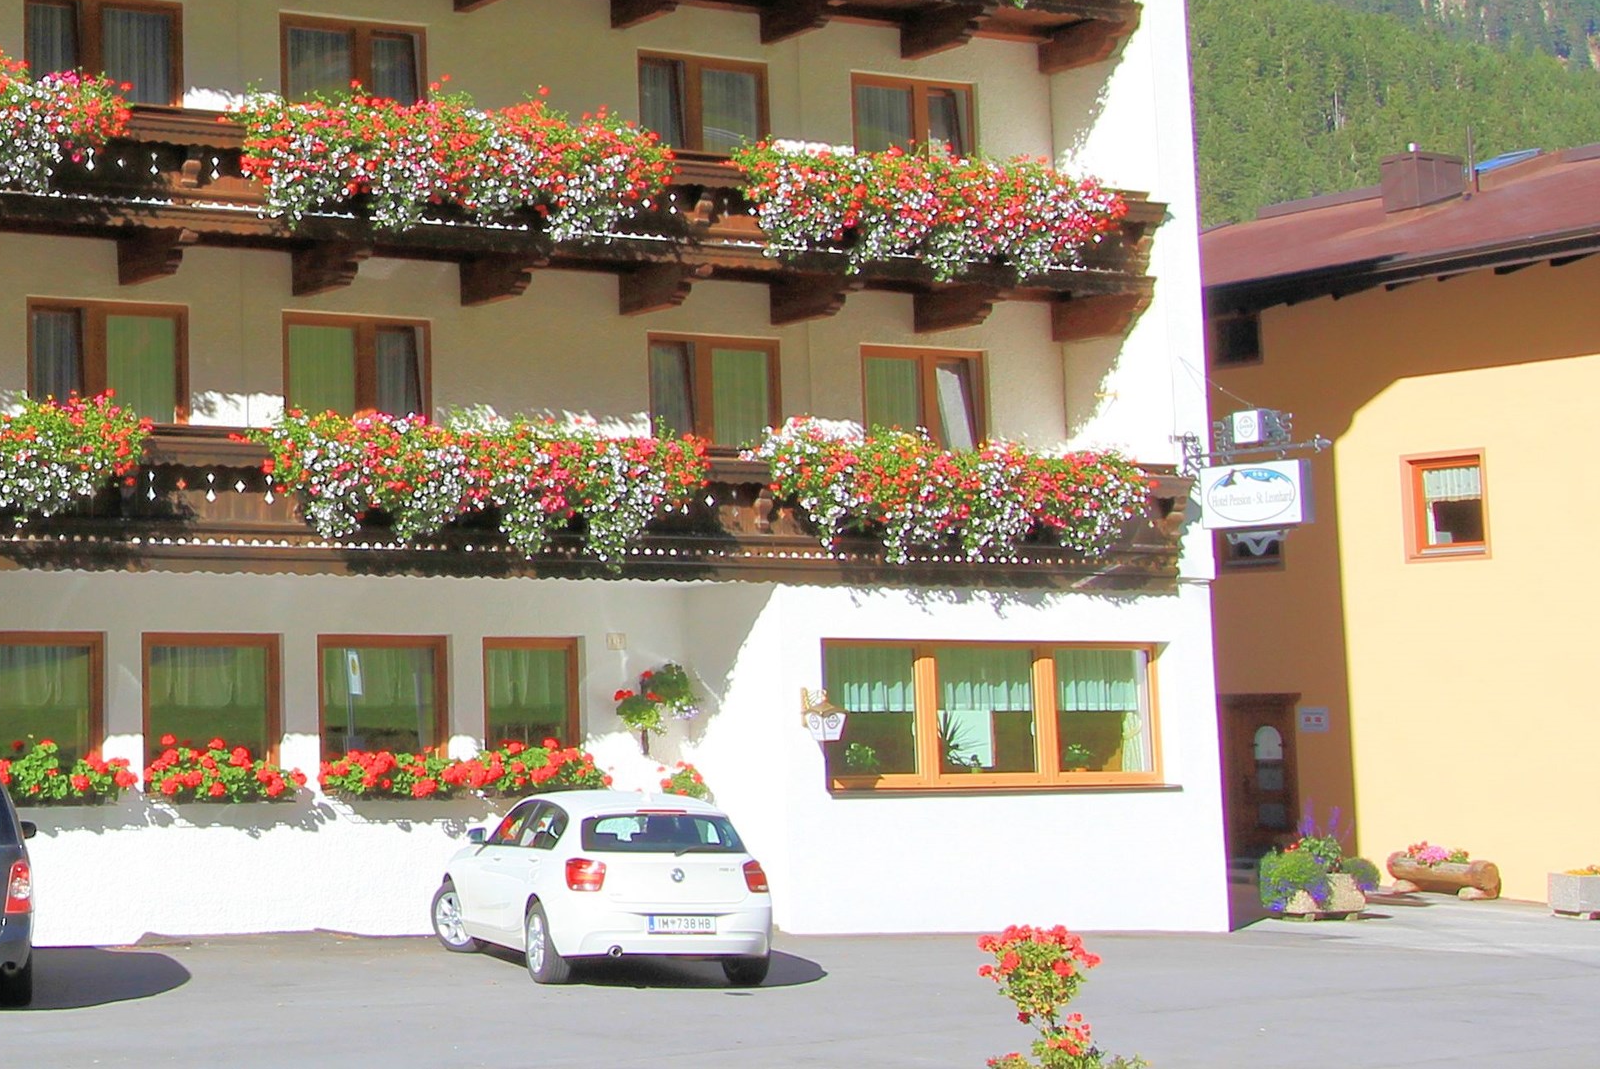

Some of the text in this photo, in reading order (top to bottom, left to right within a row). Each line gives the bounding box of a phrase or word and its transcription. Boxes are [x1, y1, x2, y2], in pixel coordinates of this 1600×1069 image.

[1211, 494, 1227, 507] Hotel
[1229, 493, 1251, 506] Pension
[658, 918, 711, 930] IM 738 HB
